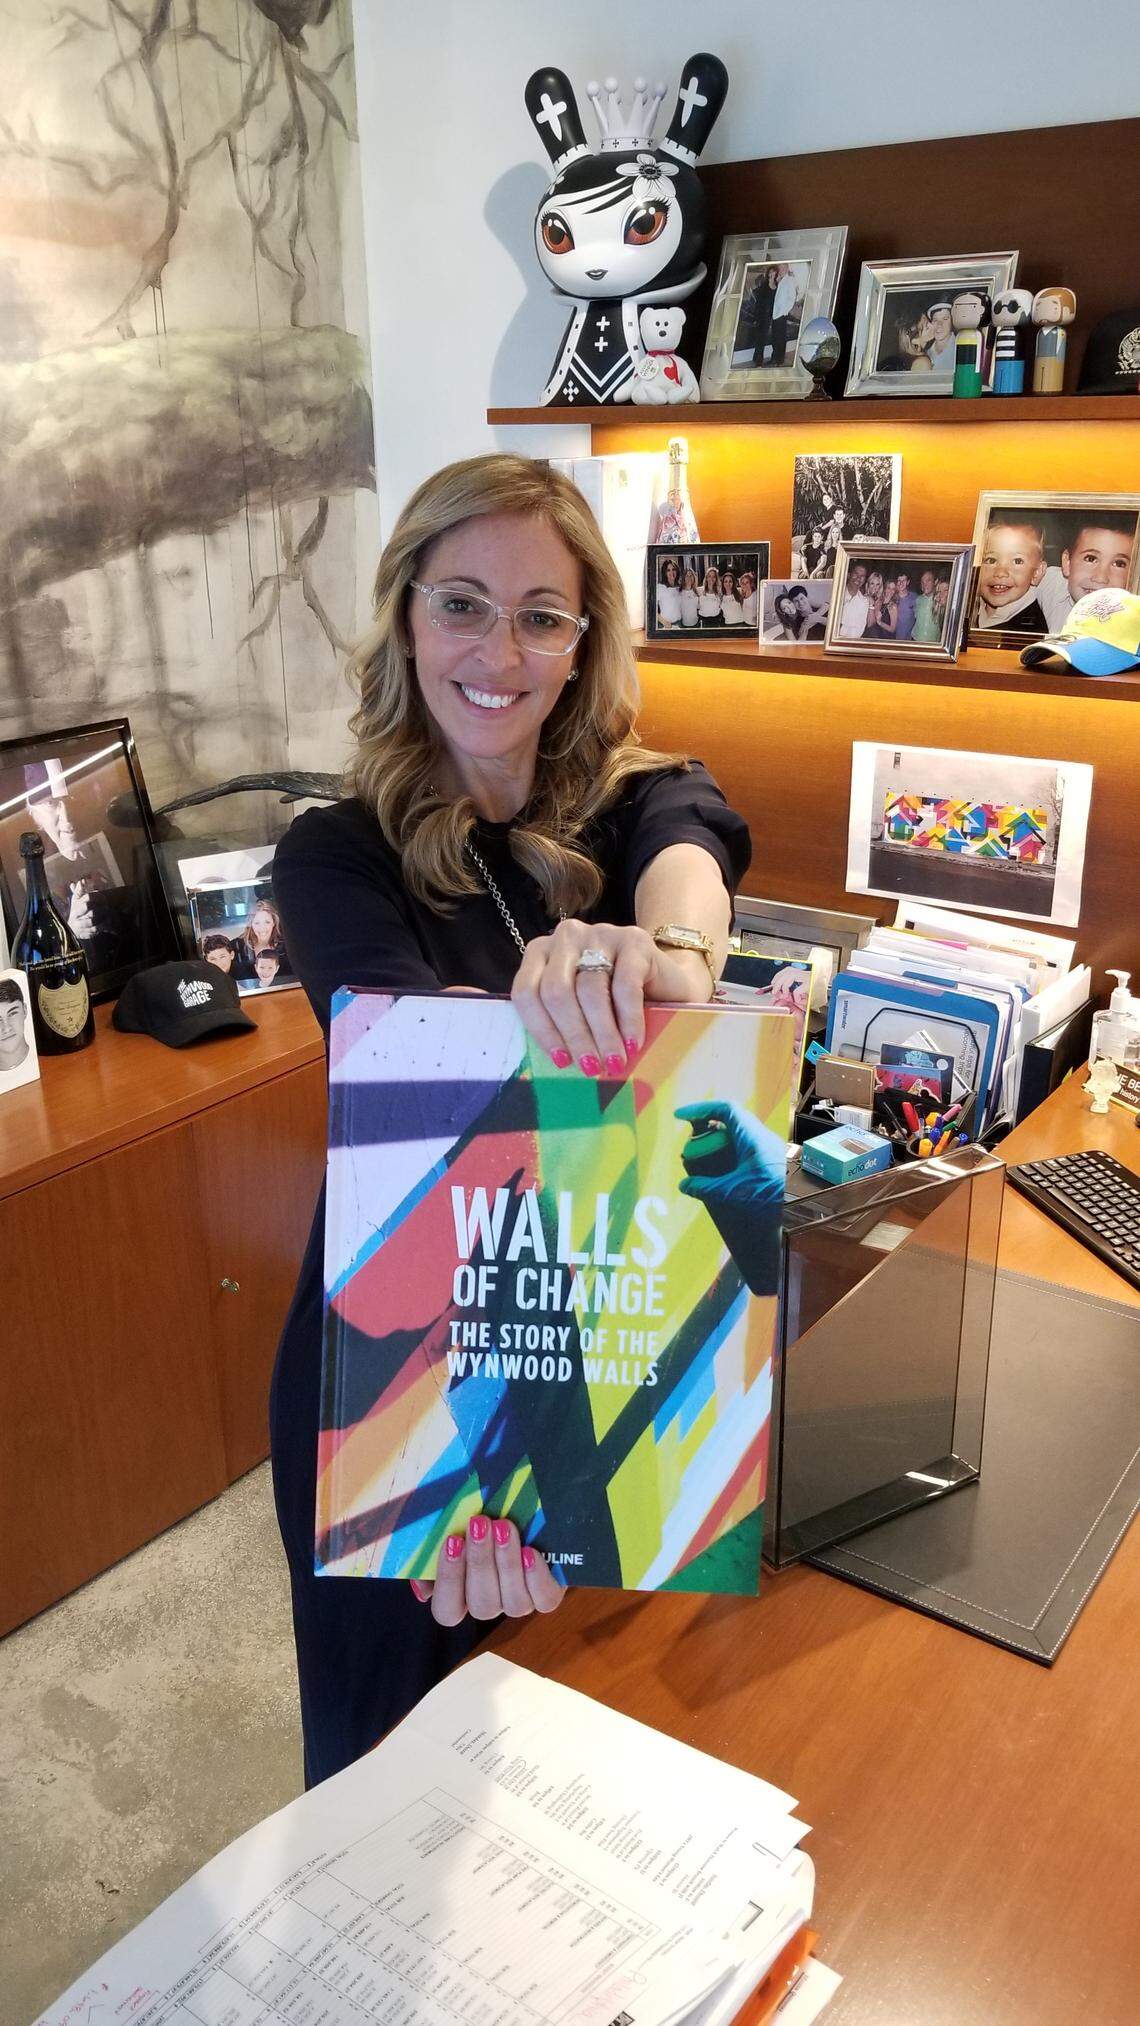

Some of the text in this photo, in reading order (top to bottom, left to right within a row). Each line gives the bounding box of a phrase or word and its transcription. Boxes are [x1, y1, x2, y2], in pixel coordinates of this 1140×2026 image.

[183, 990, 211, 1008] GARAGE
[1119, 1088, 1140, 1104] history
[847, 1161, 864, 1177] echo
[450, 1185, 668, 1269] WALLS
[453, 1263, 667, 1316] OF CHANGE
[449, 1321, 659, 1357] THE STORY OF THE
[447, 1351, 659, 1386] WYNWOOD WALLS
[541, 1551, 584, 1566] ULINE
